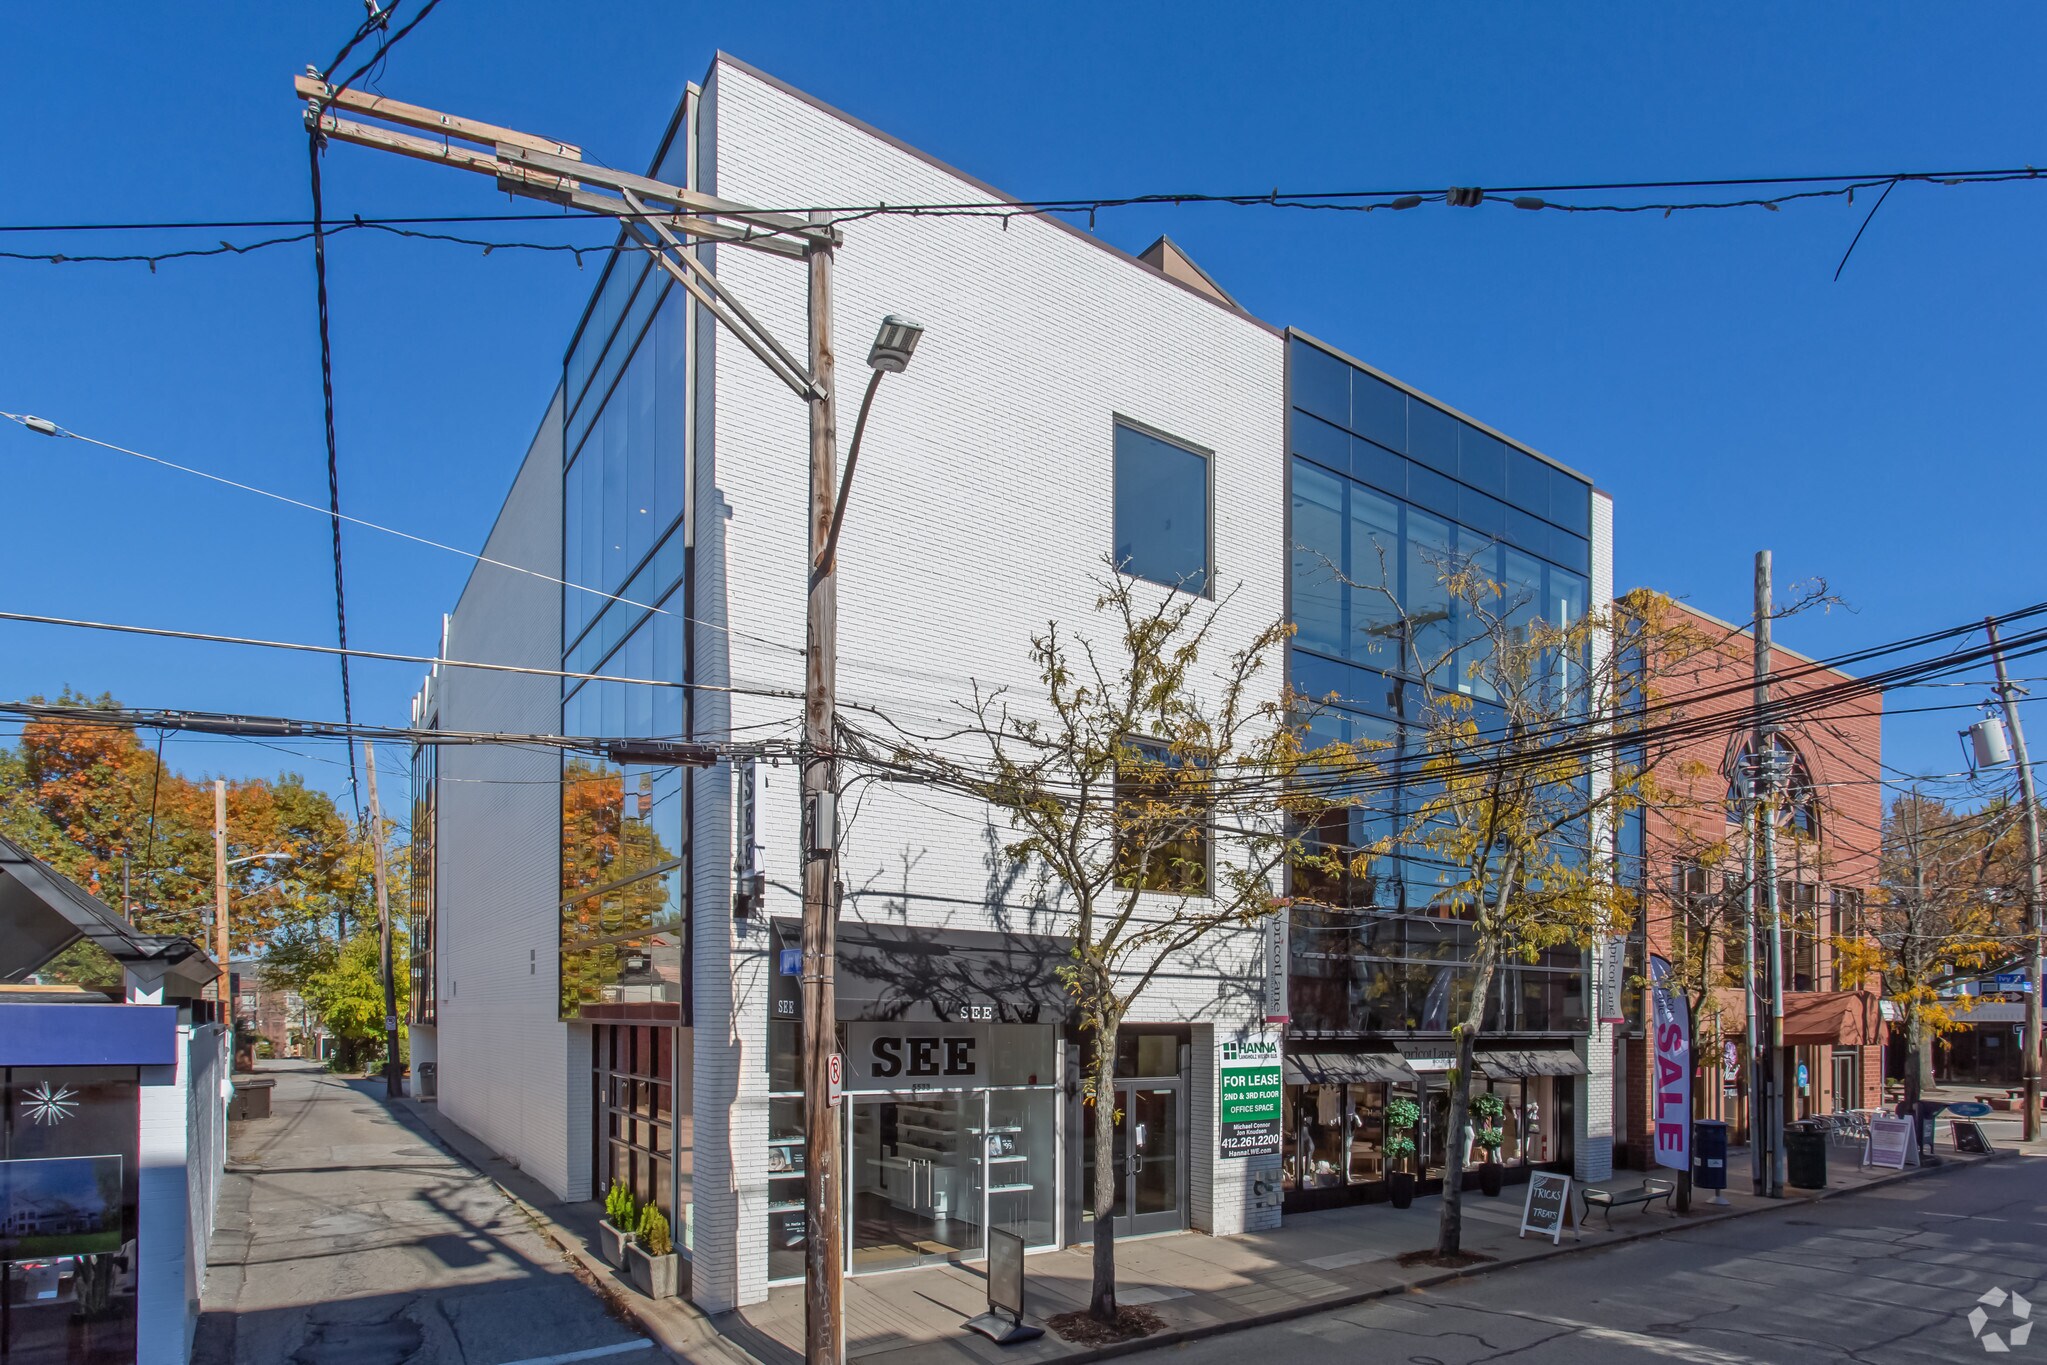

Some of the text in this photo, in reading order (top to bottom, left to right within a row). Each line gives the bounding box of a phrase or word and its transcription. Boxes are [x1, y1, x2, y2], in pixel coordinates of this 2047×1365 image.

[1999, 975, 2011, 983] Ivy
[778, 1000, 795, 1014] SEE
[960, 1006, 993, 1020] SEE
[1239, 1042, 1277, 1053] HANNA
[871, 1036, 976, 1078] SEE
[912, 1083, 931, 1091] 5533
[1223, 1074, 1279, 1088] FOR LEASE
[1657, 1022, 1684, 1153] SALE
[1223, 1090, 1279, 1101] 2ND & 3RD FLOOR
[1230, 1103, 1274, 1114] OFFICE SPACE
[1233, 1123, 1253, 1131] Michael
[1221, 1134, 1279, 1149] 412.261.2200
[1533, 1187, 1562, 1201] TRICKS
[1533, 1207, 1558, 1220] TREATS
